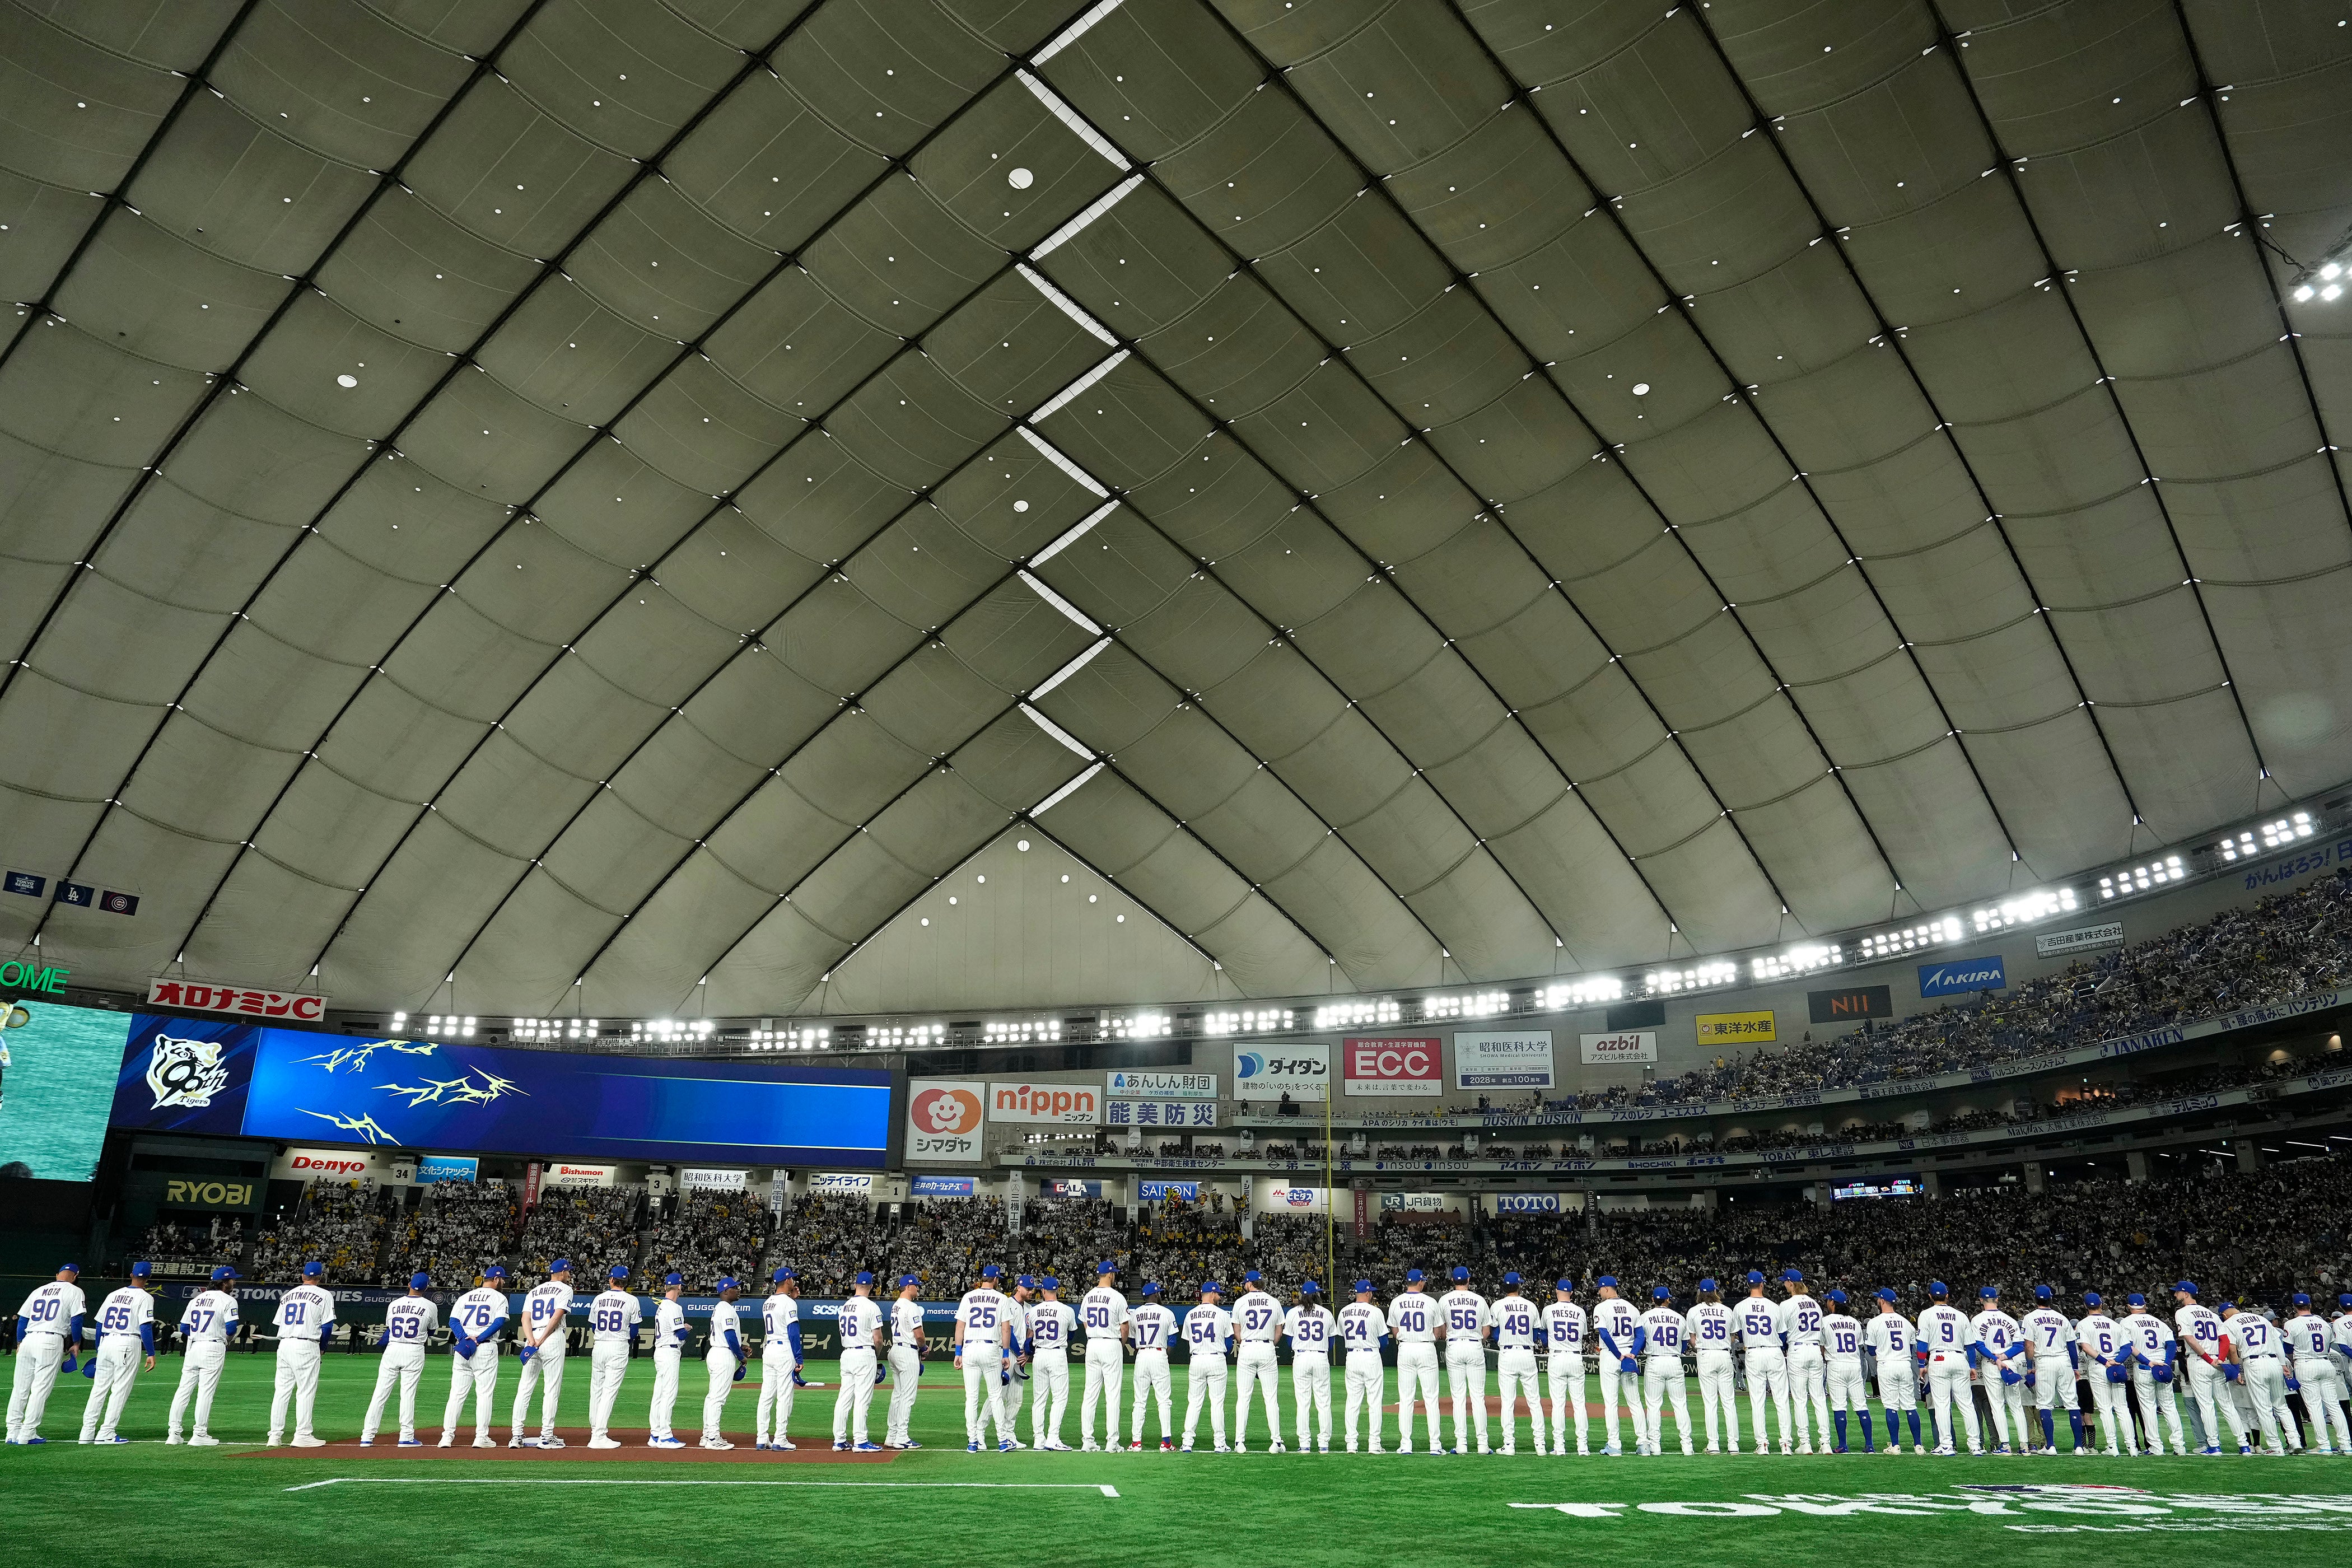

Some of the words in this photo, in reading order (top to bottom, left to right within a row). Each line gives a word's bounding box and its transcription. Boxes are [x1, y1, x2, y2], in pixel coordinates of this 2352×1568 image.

[2047, 926, 2122, 946] 吉田産業株式会社
[1943, 970, 2001, 986] AKIRA
[152, 982, 322, 1019] オロナミンC
[1714, 1020, 1772, 1035] 東洋水産
[1479, 1041, 1547, 1052] 昭和医科大学
[1596, 1035, 1640, 1051] azbil
[1355, 1051, 1430, 1076] ECC
[1590, 1053, 1648, 1061] アズビル株式会社
[1268, 1058, 1326, 1075] ダイダン
[1127, 1074, 1210, 1090] あんしん財団
[1242, 1081, 1325, 1091] 建物の「いのち」をつくる。
[180, 1095, 209, 1105] Tigers
[997, 1085, 1094, 1116] nippn
[1064, 1113, 1093, 1122] ニップン
[1109, 1102, 1215, 1126] 能美防災
[2047, 1114, 2108, 1132] 太陽工業株式会社
[917, 1137, 972, 1153] シマダヤ
[1921, 1133, 1970, 1147] 日本事務器
[1808, 1145, 1855, 1158] 東レ建設
[291, 1156, 365, 1174] Denyo
[418, 1166, 475, 1176] 文化シャッター
[561, 1166, 603, 1176] Bishamon
[1154, 1159, 1225, 1168] 中部衛生検査センター
[396, 1169, 408, 1179] 34
[684, 1172, 743, 1183] 昭和医科大学
[811, 1175, 871, 1187] ニッテイライフ
[526, 1163, 538, 1203] 後楽園ホール
[654, 1180, 660, 1188] 3
[914, 1182, 963, 1190] 三井のカーシェアーズ
[1055, 1183, 1088, 1193] GALA
[1141, 1185, 1192, 1197] SAISON
[772, 1180, 783, 1211] 関電工
[894, 1187, 898, 1196] 1
[1385, 1197, 1399, 1205] JR
[1406, 1197, 1441, 1206] JR貨物
[1500, 1196, 1557, 1210] TOTO
[1010, 1194, 1019, 1230] 三機工業
[112, 1295, 133, 1305] JAVIER
[532, 1288, 562, 1298] FLAHERTY
[969, 1296, 1000, 1304] WORKMAN
[1088, 1296, 1110, 1304] TAILLON
[31, 1299, 60, 1322] 90
[195, 1299, 214, 1307] SMITH
[532, 1299, 556, 1320] 84
[599, 1299, 626, 1309] HOTTOVY
[763, 1303, 776, 1312] BERRY
[1399, 1301, 1425, 1309] KELLER
[1449, 1298, 1478, 1308] PEARSON
[1752, 1304, 1764, 1313] REA
[104, 1307, 131, 1331] 65
[284, 1303, 306, 1325] 81
[393, 1306, 425, 1317] CABREJA
[463, 1305, 491, 1326] 76
[969, 1307, 996, 1328] 25
[1038, 1309, 1057, 1317] BUSCH
[1087, 1307, 1109, 1328] 50
[1191, 1310, 1216, 1320] BRASIER
[1245, 1309, 1272, 1330] 37
[1299, 1310, 1324, 1319] MORGAN
[1342, 1309, 1370, 1318] THIELBAR
[1450, 1309, 1476, 1329] 56
[1552, 1310, 1580, 1319] PRESSLY
[1700, 1308, 1724, 1317] STEELE
[1936, 1313, 1956, 1321] AMAYA
[191, 1310, 215, 1333] 97
[392, 1317, 420, 1339] 63
[597, 1310, 623, 1332] 68
[839, 1316, 857, 1337] 36
[1400, 1312, 1425, 1332] 40
[1505, 1315, 1529, 1335] 49
[1612, 1317, 1632, 1337] 16
[1649, 1315, 1679, 1326] PALENCIA
[1746, 1315, 1772, 1335] 53
[1798, 1312, 1820, 1332] 32
[1830, 1322, 1855, 1331] IMANAGA
[2034, 1317, 2063, 1327] SWANSON
[2237, 1316, 2260, 1325] SUZUKI
[1035, 1320, 1059, 1341] 29
[1138, 1324, 1160, 1345] 17
[1191, 1322, 1216, 1343] 54
[1298, 1320, 1324, 1341] 33
[1345, 1320, 1367, 1340] 24
[1553, 1321, 1579, 1342] 55
[1653, 1326, 1678, 1346] 48
[1701, 1320, 1726, 1340] 35
[1942, 1323, 1953, 1343] 9
[1993, 1328, 2005, 1348] 4
[2045, 1327, 2057, 1347] 7
[2195, 1320, 2218, 1341] 30
[2242, 1324, 2267, 1346] 27
[1836, 1333, 1856, 1353] 18
[1890, 1331, 1903, 1351] 5
[2099, 1333, 2113, 1354] 6
[2144, 1329, 2158, 1349] 3
[2311, 1333, 2324, 1352] 8
[1506, 1501, 2173, 1517] TOKYO
